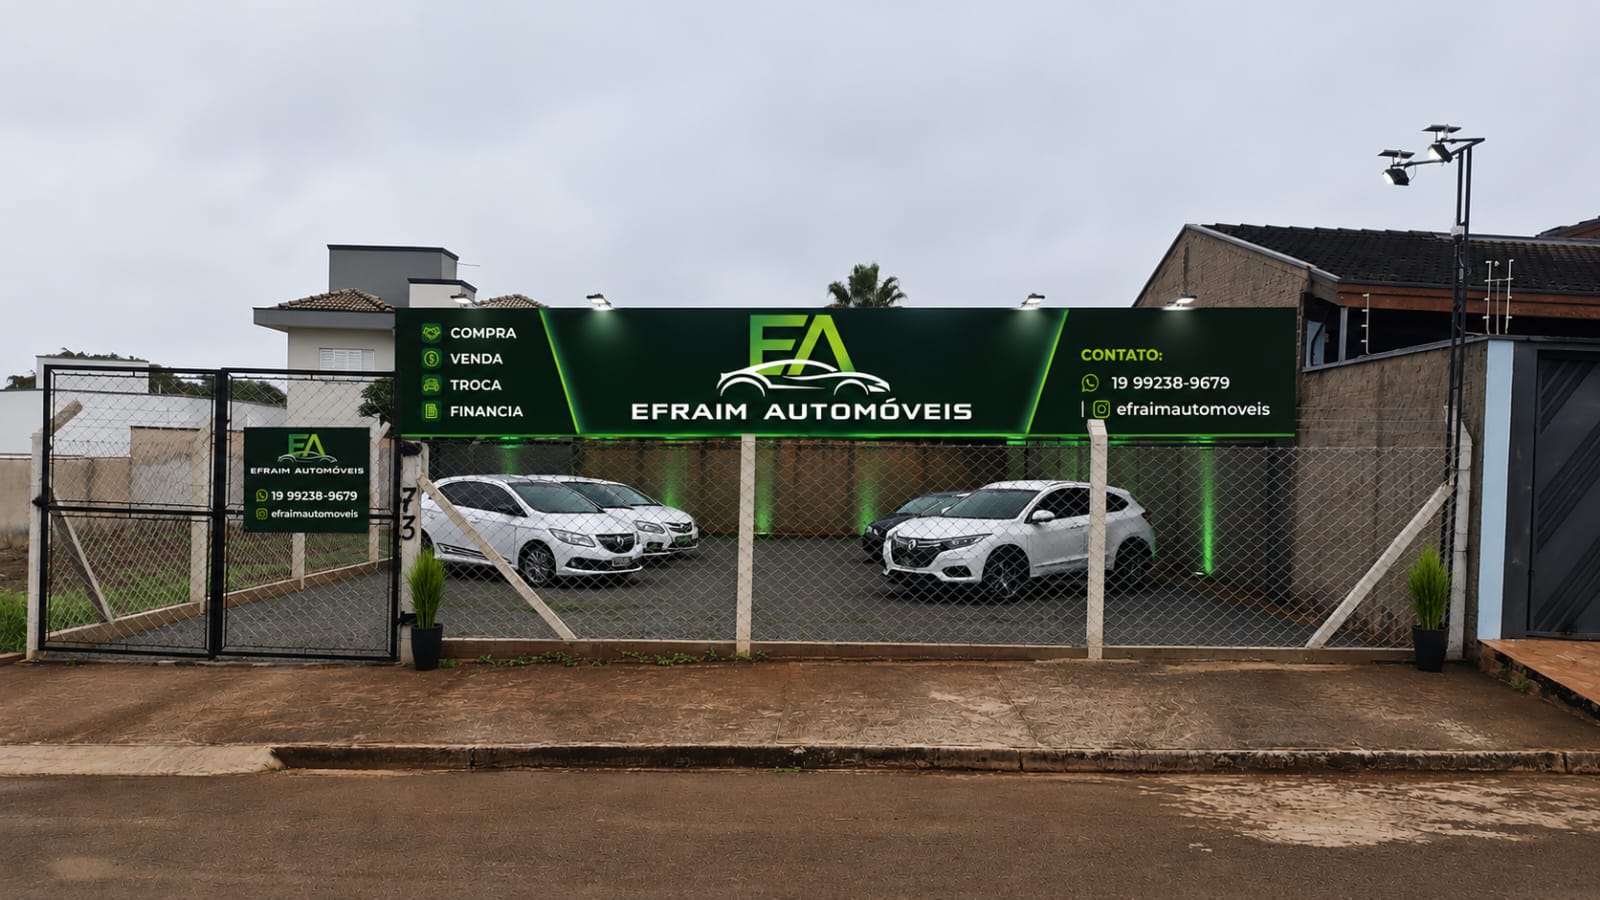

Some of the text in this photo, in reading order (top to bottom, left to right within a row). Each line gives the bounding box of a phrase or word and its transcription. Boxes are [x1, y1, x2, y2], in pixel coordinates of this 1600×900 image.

[451, 328, 516, 338] COMPRA
[450, 353, 503, 364] VENDA
[1081, 349, 1162, 360] CONTATO:
[450, 380, 501, 390] TROCA
[1112, 377, 1229, 389] 19 99238-9679
[451, 406, 523, 417] FINANCIA
[632, 398, 971, 420] EFRAIM AUTOMÓVEIS
[1117, 402, 1270, 415] efraimautomoveis
[295, 466, 364, 474] AUTOMÓVEIS
[272, 491, 357, 501] 19 99238-9679
[271, 510, 358, 518] efraimautomoveis
